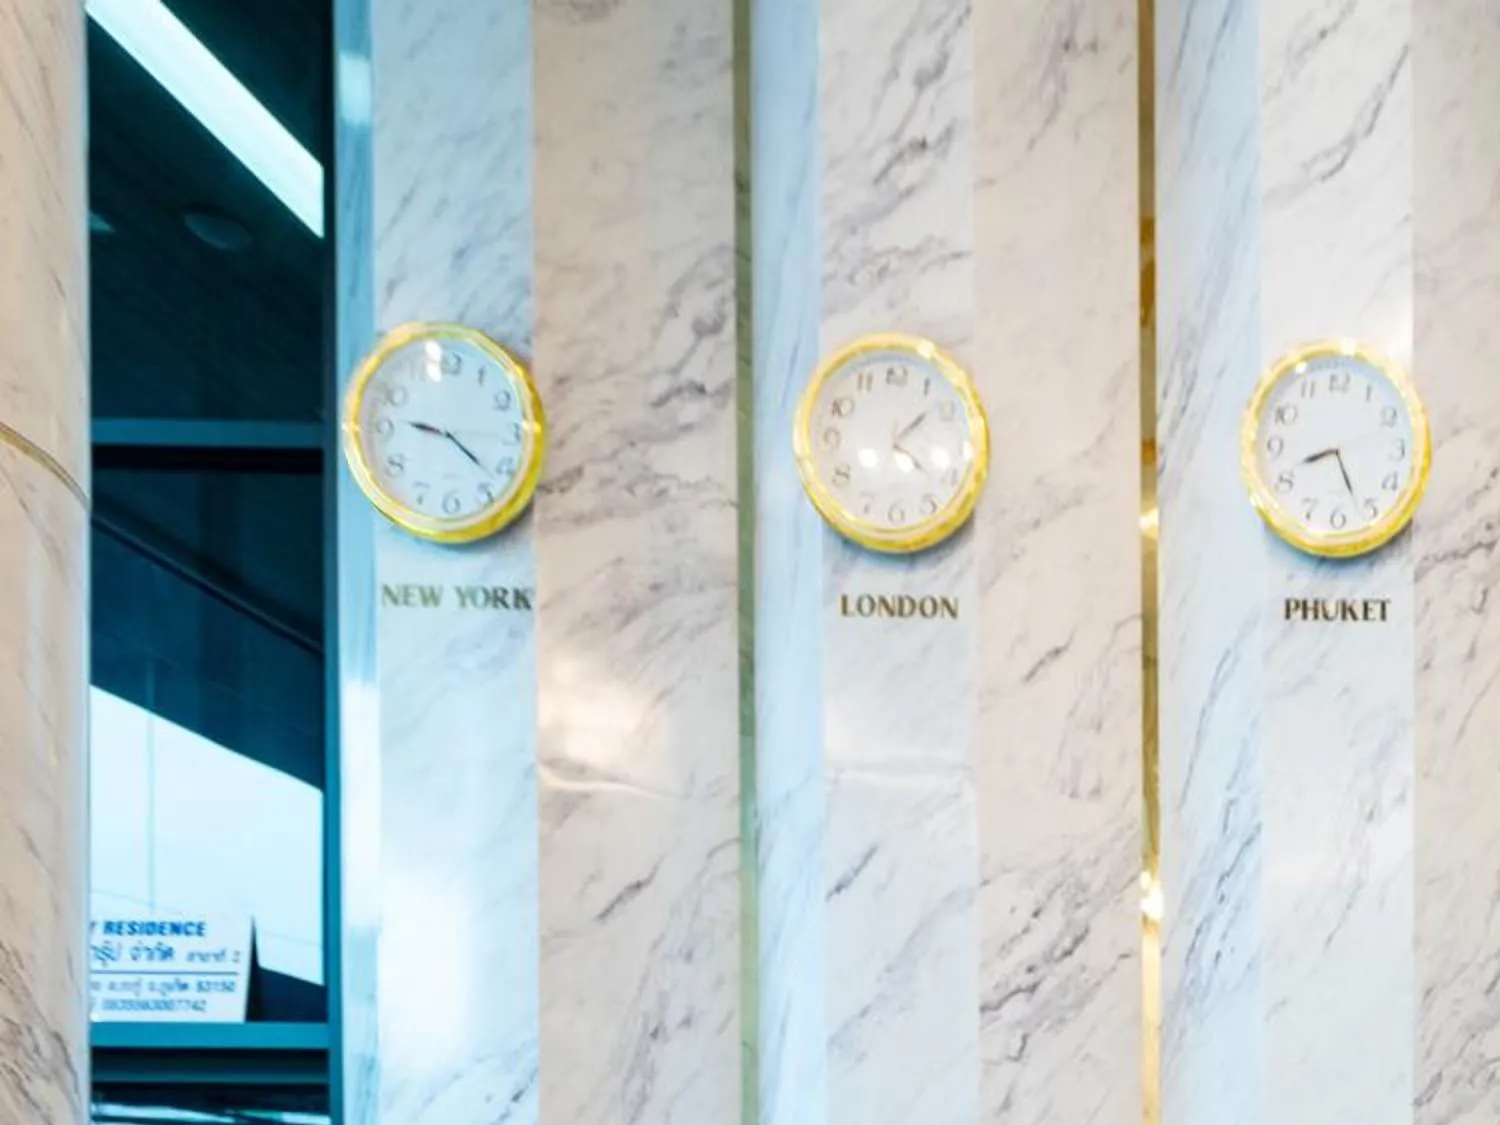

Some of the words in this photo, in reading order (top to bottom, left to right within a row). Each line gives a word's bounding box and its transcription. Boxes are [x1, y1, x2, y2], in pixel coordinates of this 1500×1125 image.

[477, 368, 486, 385] 1
[857, 371, 873, 392] 11
[886, 367, 908, 387] 12
[923, 377, 931, 396] 1
[1329, 374, 1351, 392] 12
[1300, 380, 1316, 398] 11
[1365, 385, 1373, 402] 1
[493, 390, 511, 412] 2
[831, 398, 855, 417] 10
[1274, 404, 1298, 425] 10
[1380, 406, 1398, 427] 2
[376, 417, 394, 441] 9
[503, 423, 521, 444] 3
[824, 428, 841, 448] 9
[1267, 435, 1284, 457] 9
[1389, 438, 1406, 461] 3
[387, 454, 405, 477] 8
[496, 459, 514, 478] 4
[832, 463, 851, 487] 8
[1274, 470, 1294, 492] 8
[1381, 472, 1399, 492] 4
[413, 481, 431, 506] 7
[442, 491, 461, 513] 6
[477, 482, 497, 504] 5
[859, 491, 875, 514] 7
[888, 504, 905, 524] 6
[919, 495, 937, 516] 5
[1301, 498, 1318, 521] 7
[1362, 498, 1379, 520] 5
[1330, 508, 1346, 529] 6
[382, 584, 443, 608] NEW
[455, 586, 532, 610] YORK
[840, 593, 960, 619] LONDON
[1284, 597, 1391, 622] PHUKET
[103, 920, 207, 937] RESIDENCE
